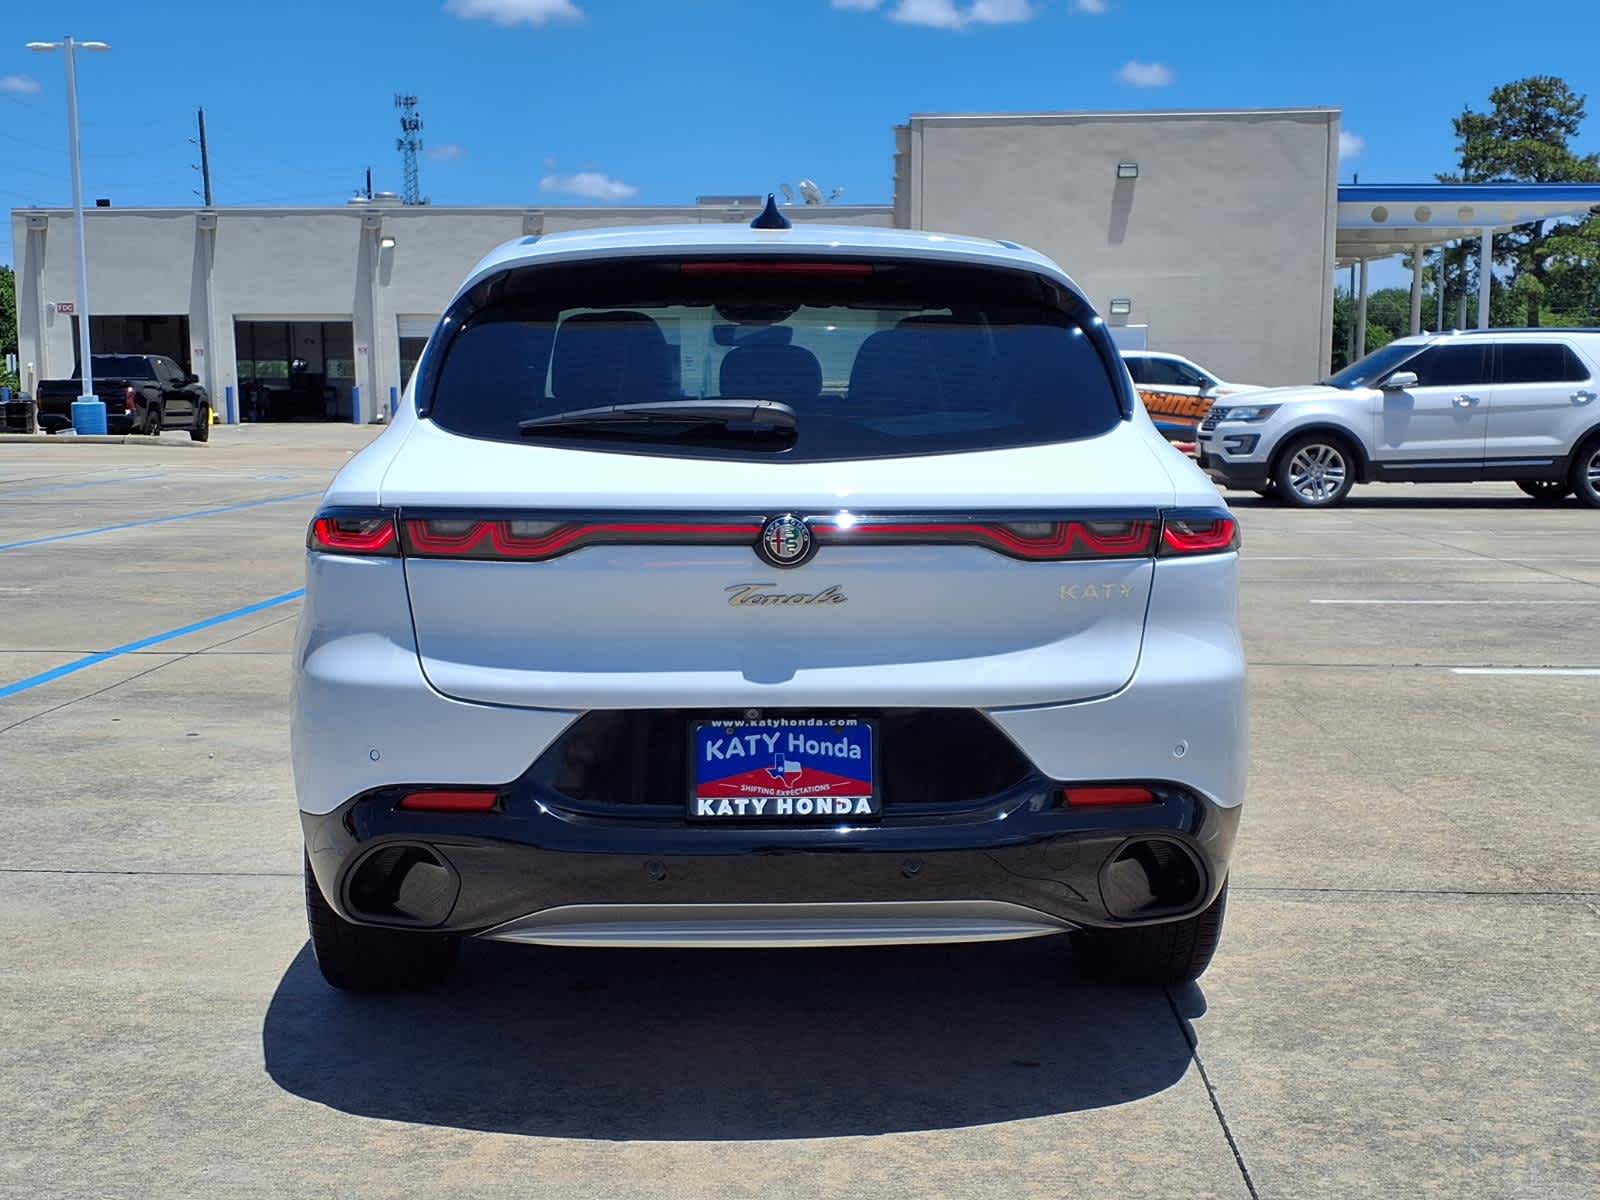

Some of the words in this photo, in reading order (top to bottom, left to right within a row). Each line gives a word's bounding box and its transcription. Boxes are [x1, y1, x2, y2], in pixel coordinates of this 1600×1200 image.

[1059, 584, 1136, 600] KATY
[711, 718, 858, 728] www.katyhonda.com
[706, 732, 781, 761] KATY
[788, 733, 861, 759] Honda
[740, 784, 774, 796] SHIFTING
[775, 783, 831, 796] EXPECTATIONS
[697, 797, 769, 816] KATY
[777, 797, 872, 815] HONDA
